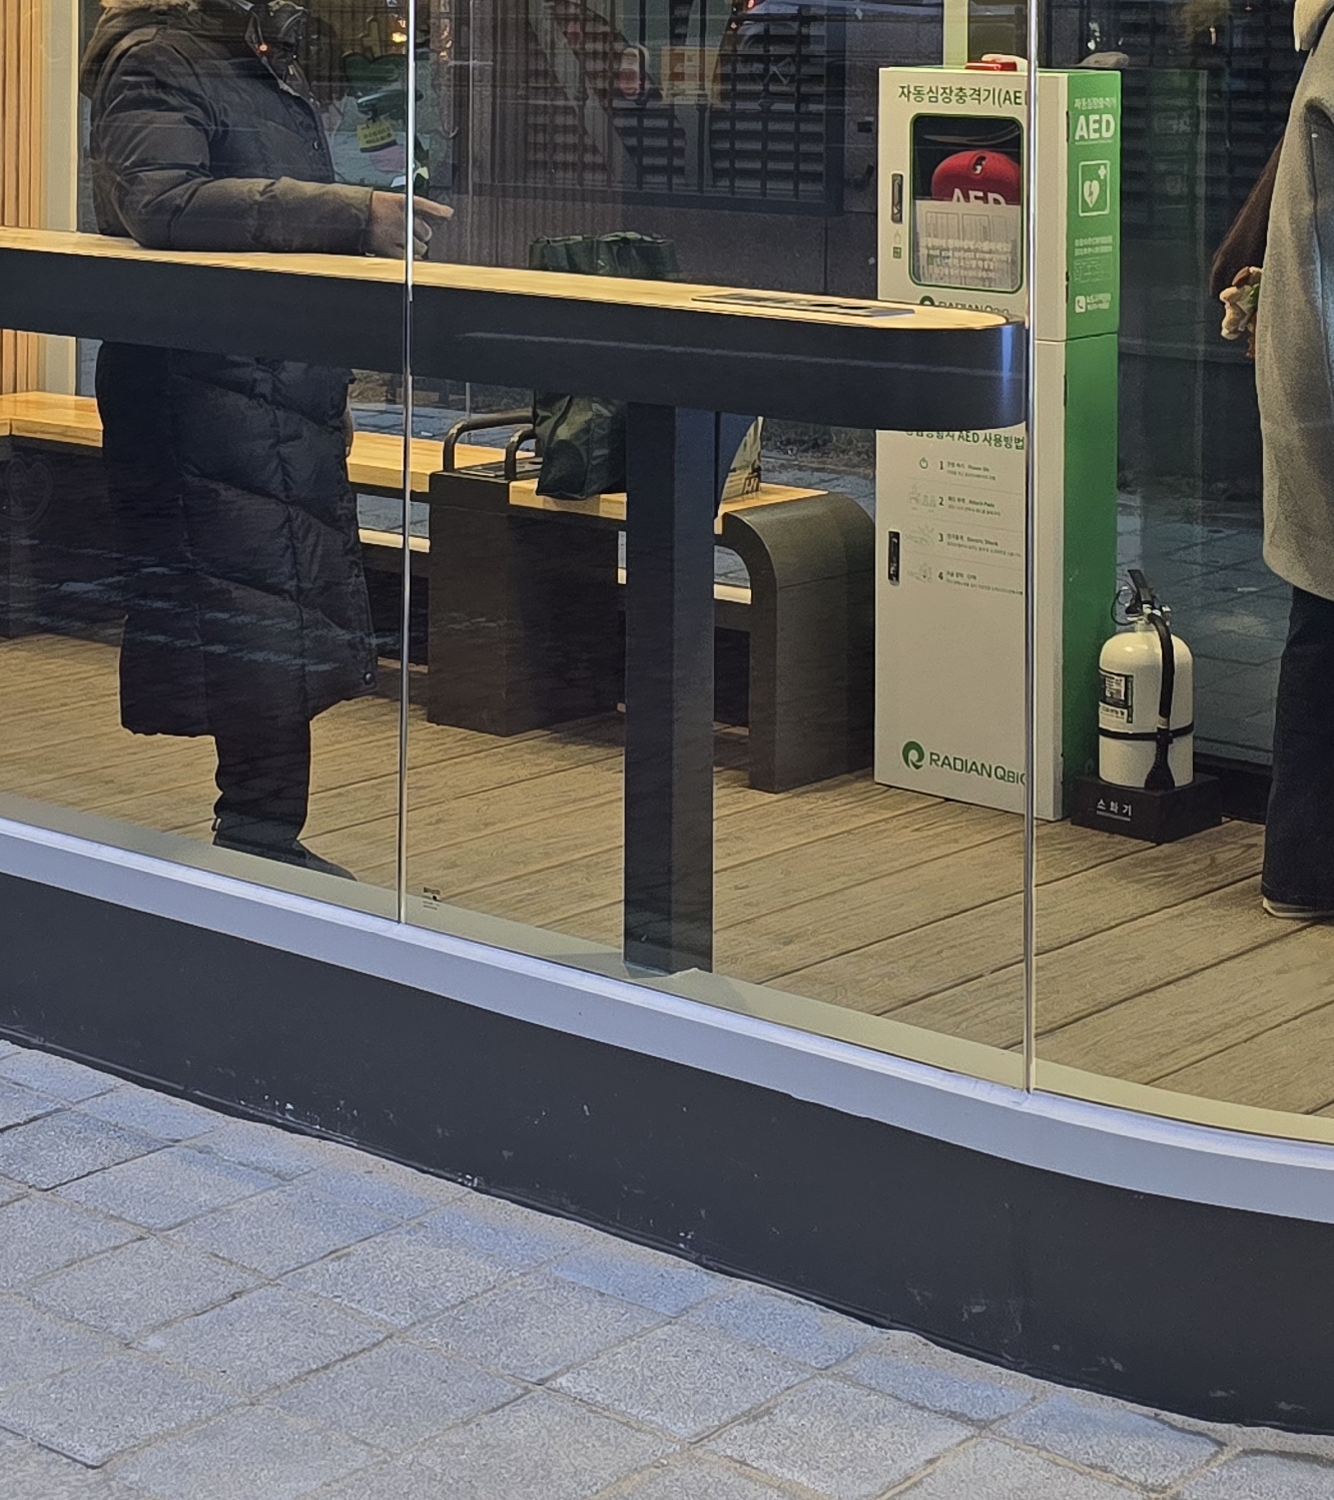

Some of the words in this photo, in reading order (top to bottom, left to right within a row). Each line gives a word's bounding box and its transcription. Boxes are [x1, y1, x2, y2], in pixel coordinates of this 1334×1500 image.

[1074, 113, 1116, 141] AED
[938, 496, 944, 506] 2
[938, 533, 944, 542] 3
[938, 571, 944, 581] 4
[929, 751, 992, 779] RADIAN
[1096, 798, 1133, 817] 소화기
